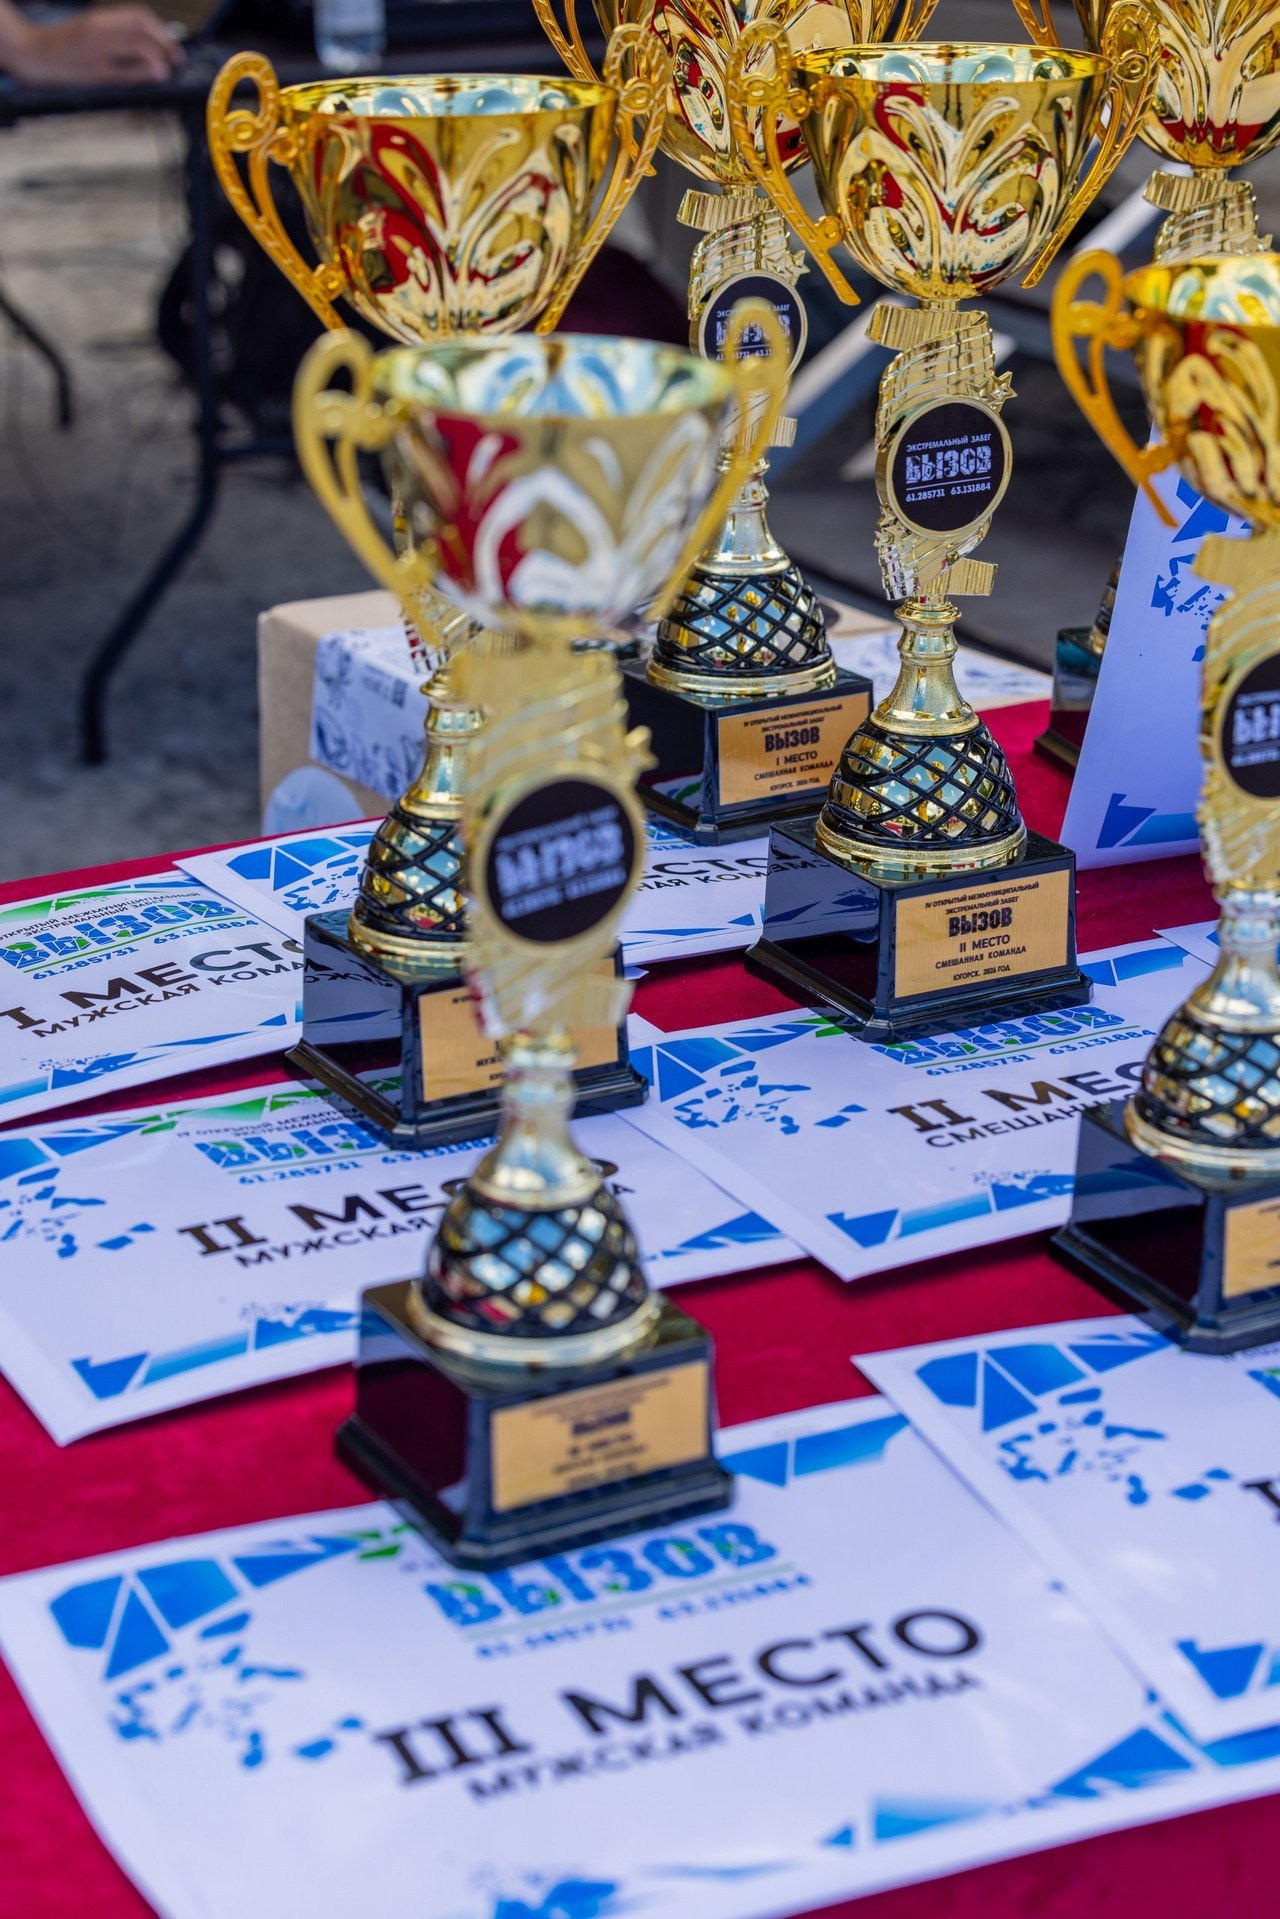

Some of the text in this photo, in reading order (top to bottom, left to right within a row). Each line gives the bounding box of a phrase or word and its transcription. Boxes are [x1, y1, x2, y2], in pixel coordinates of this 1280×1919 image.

[906, 434, 991, 452] ЭКСТРЕМАЛЬНЫЙ ЗАБЕГ
[906, 445, 992, 484] ВЫЗОВ
[906, 482, 991, 502] 61.285731 63.131884
[765, 727, 820, 752] ВЫЗОВ
[754, 761, 833, 780] СМЕШАННАЯ КОМАНДА
[784, 751, 817, 764] МЕСТО
[62, 892, 201, 921] МЕЖМУНИЦИПАЛЬНЫЙ
[932, 895, 967, 907] ОТКРЫТЫЙ
[968, 882, 1039, 901] МЕЖМУНИЦИПАЛЬНЫЙ
[945, 896, 1019, 914] ЭКСТРЕМАЛЬНЫЙ ЗАБЕГ
[0, 900, 237, 970] ВЫЗОВ
[23, 899, 163, 937] ЭКСТРЕМАЛЬНЫЙ ЗАБЕГ
[949, 907, 1013, 937] ВЫЗОВ
[33, 919, 259, 980] 61.285731 63.131884
[935, 946, 1027, 969] СМЕШАННАЯ КОМАНДА
[959, 934, 1011, 952] II МЕСТО
[997, 964, 1010, 972] ГОД
[32, 982, 200, 1038] МУЖСКАЯ
[207, 961, 304, 986] КОМА
[0, 1006, 47, 1030] I
[869, 1006, 1125, 1065] ВЫЗОВ
[926, 1028, 1157, 1077] 61.285731 63.131884
[886, 1099, 979, 1133] II
[194, 1121, 382, 1169] ВЫЗ
[176, 1215, 268, 1257] II
[234, 1215, 434, 1268] МУЖСКАЯ
[424, 1522, 777, 1627] ВЫЗОВ
[373, 1608, 984, 1786] III МЕСТО
[468, 1670, 982, 1802] МУЖСКАЯ КОМАНДА
